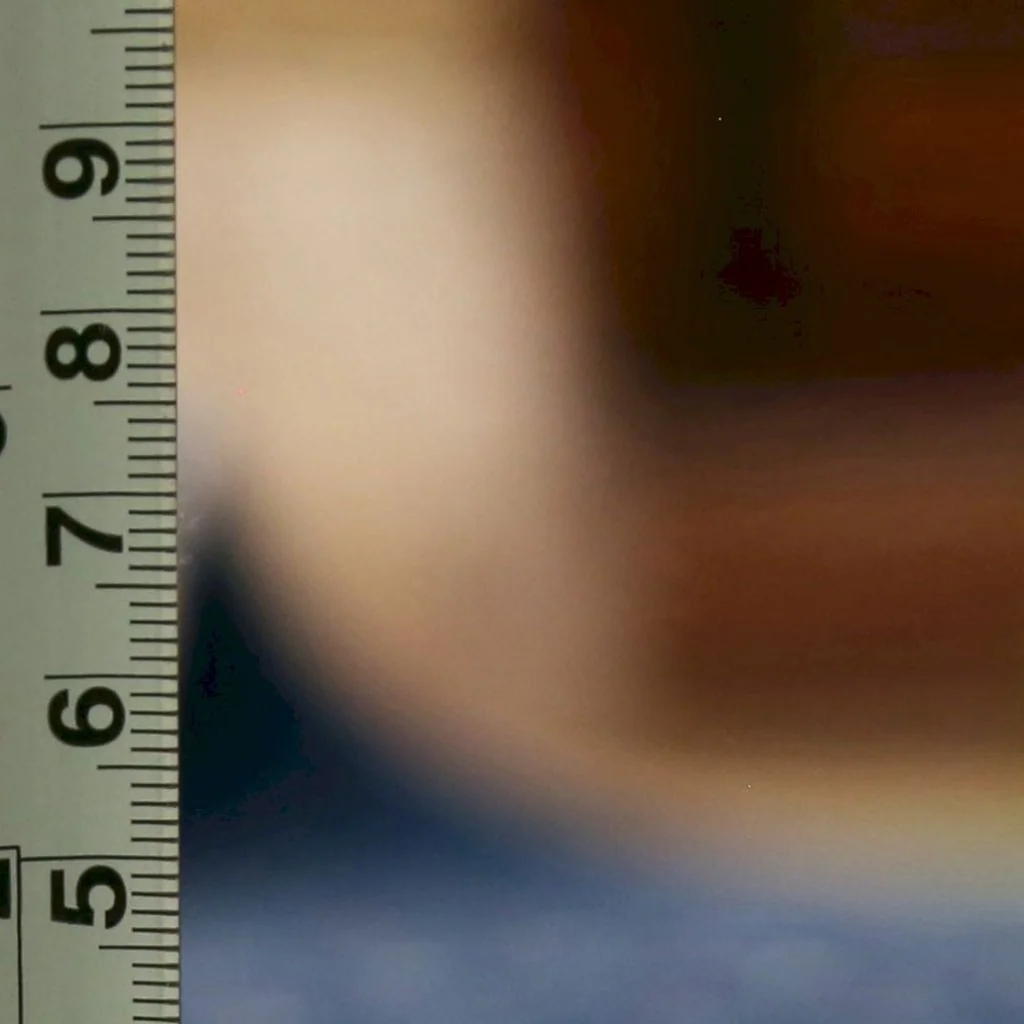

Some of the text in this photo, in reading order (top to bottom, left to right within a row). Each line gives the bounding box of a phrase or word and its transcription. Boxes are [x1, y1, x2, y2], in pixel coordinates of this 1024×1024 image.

[42, 137, 120, 200] 9
[44, 322, 121, 382] 8
[45, 506, 123, 566] 7
[47, 686, 126, 748] 6
[50, 865, 127, 930] 5
